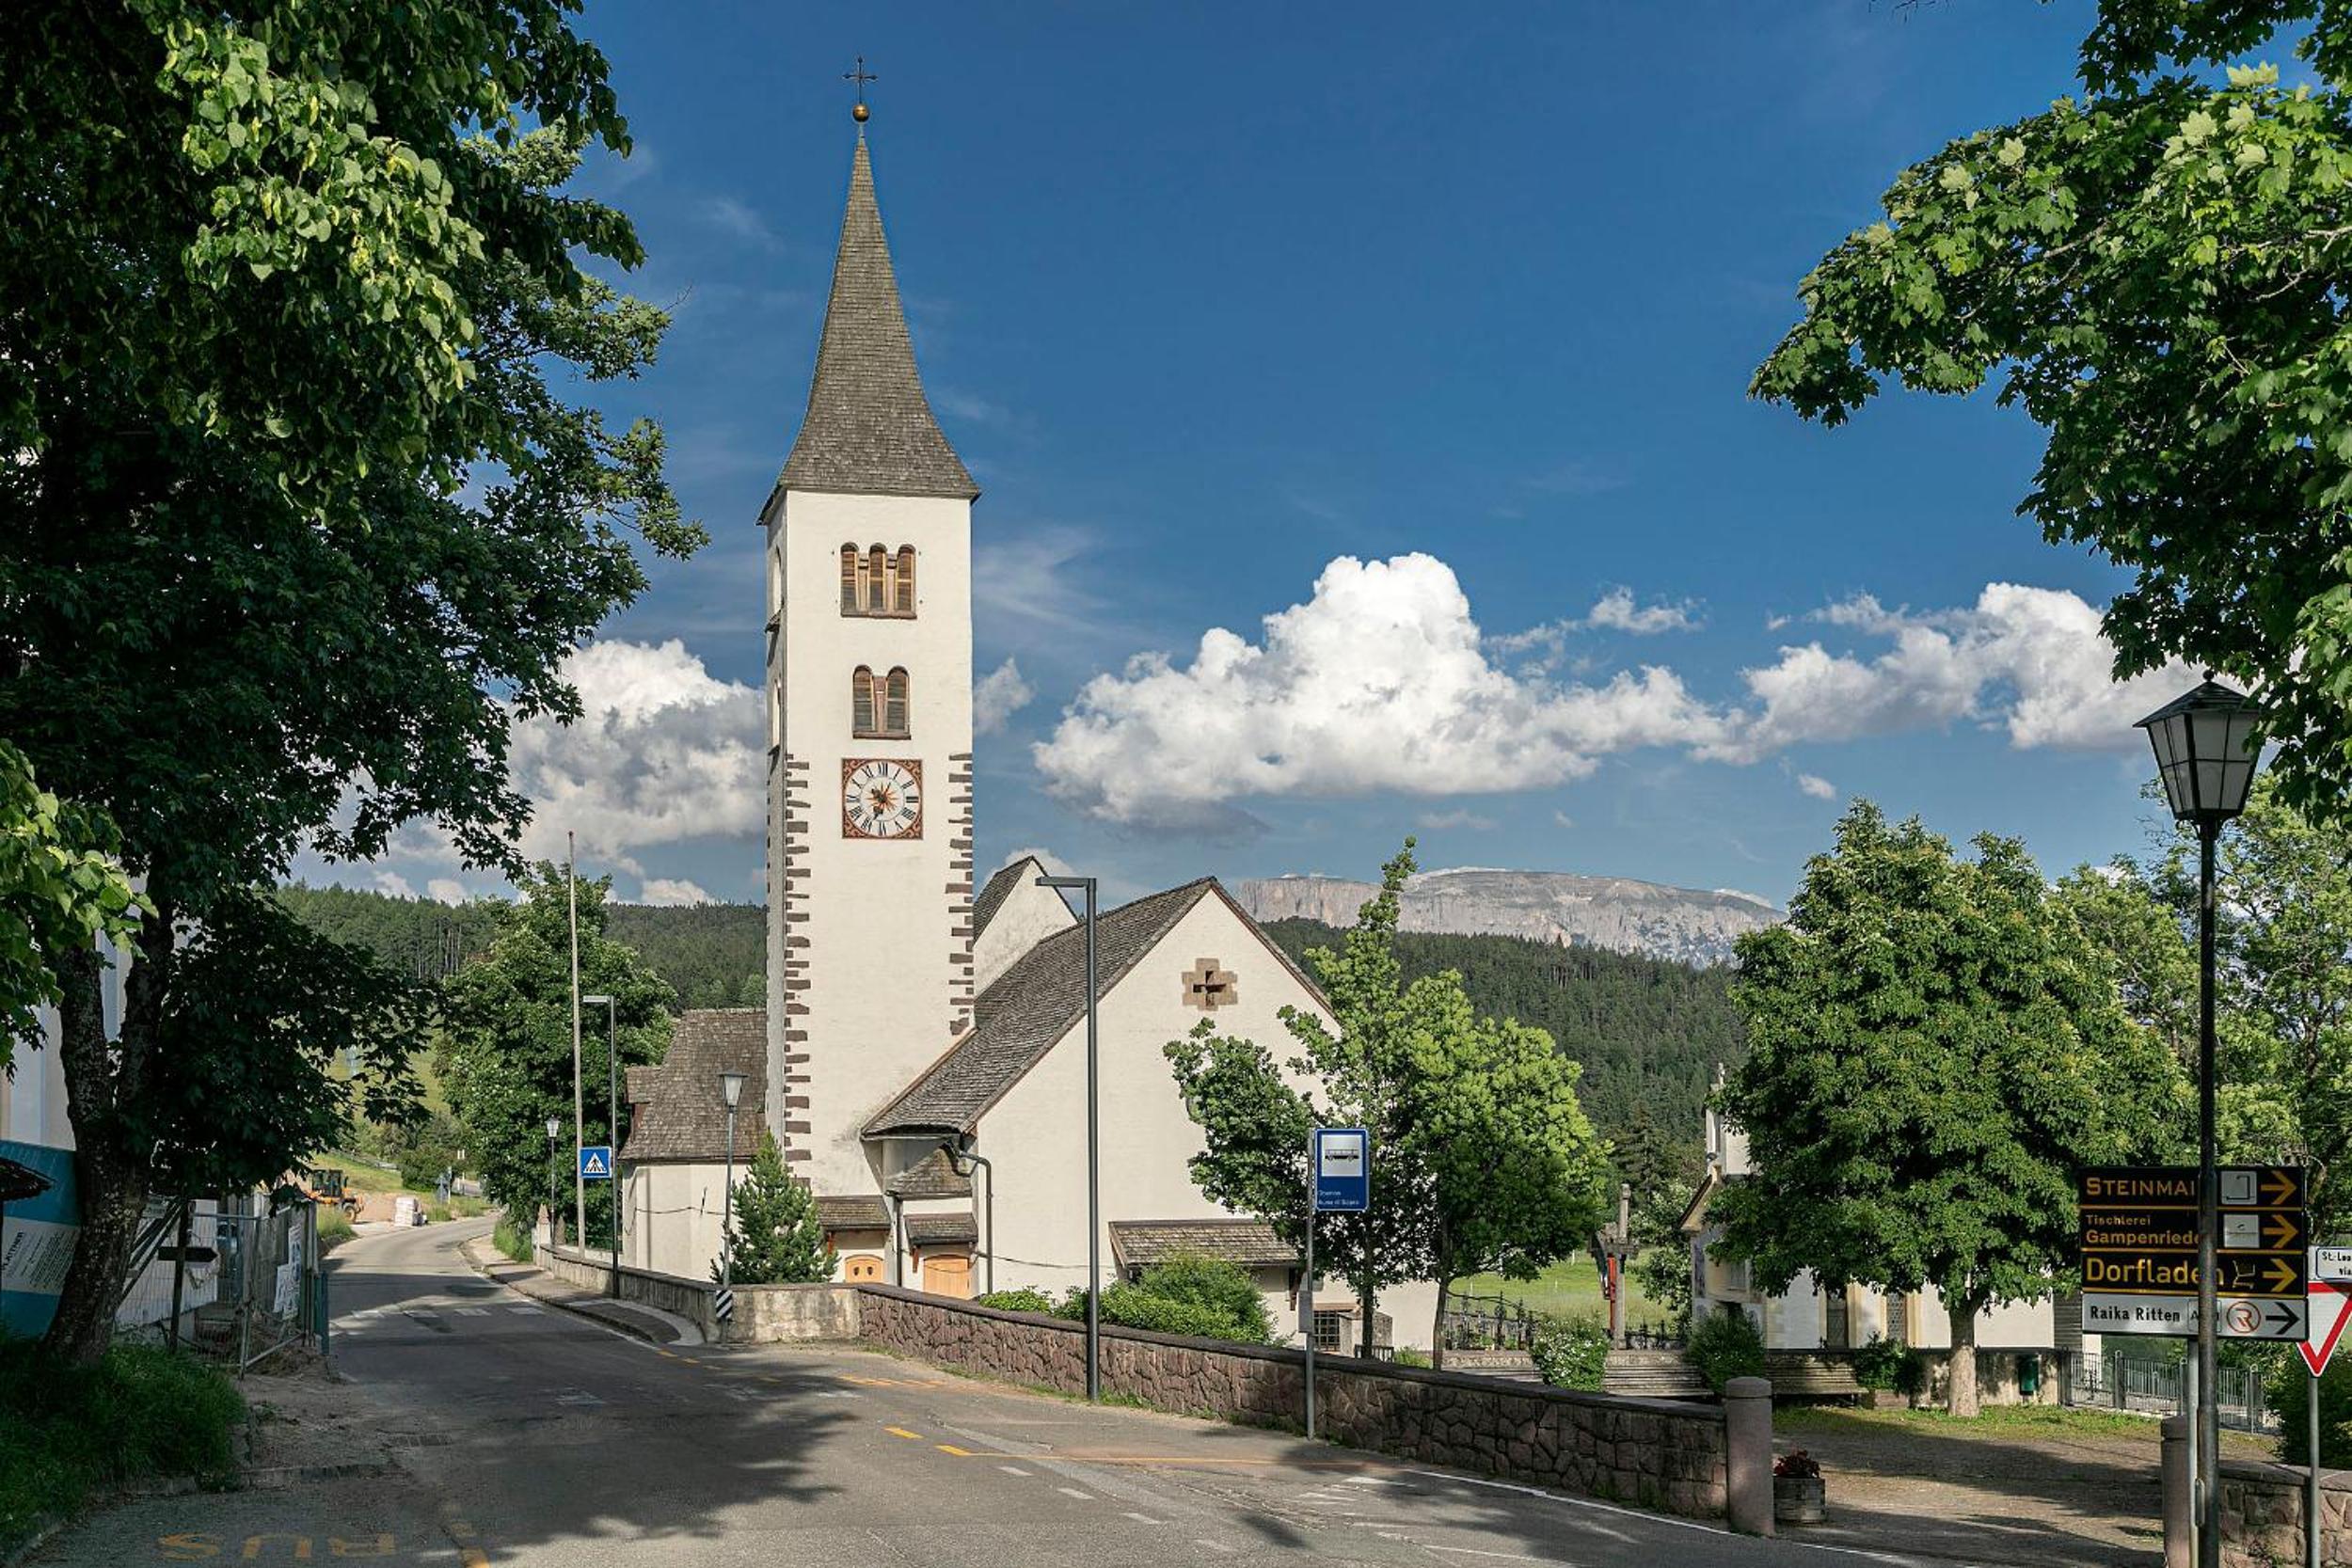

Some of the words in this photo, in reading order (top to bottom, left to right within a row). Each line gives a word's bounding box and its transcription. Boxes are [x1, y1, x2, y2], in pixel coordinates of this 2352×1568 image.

[2086, 1177, 2196, 1196] STEINMAI
[2085, 1214, 2152, 1227] Tischlerei
[2086, 1228, 2201, 1246] Gampenried
[2090, 1306, 2130, 1321] Raika
[2135, 1307, 2181, 1323] Ritten
